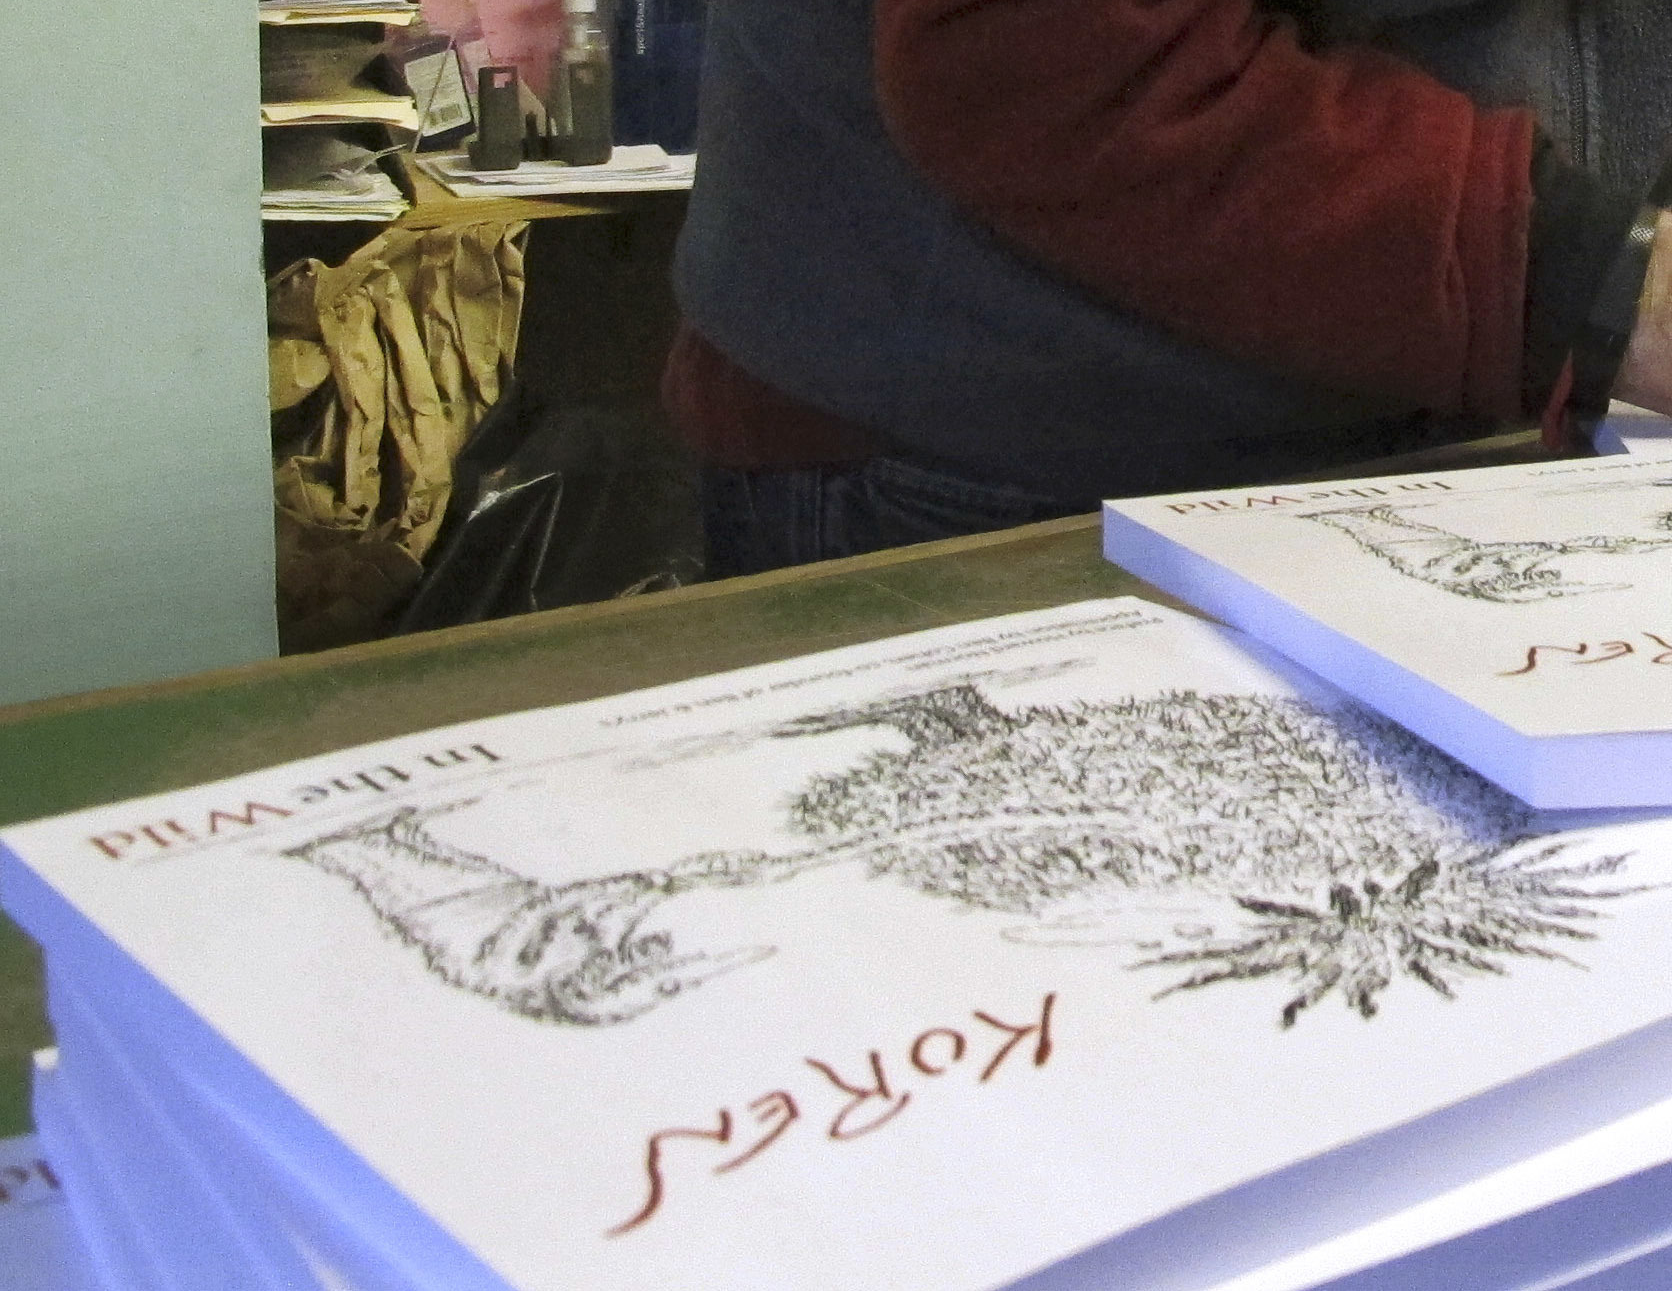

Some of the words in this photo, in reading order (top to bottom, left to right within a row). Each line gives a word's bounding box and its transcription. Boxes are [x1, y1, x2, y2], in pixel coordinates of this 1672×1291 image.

[1307, 487, 1389, 501] the
[1397, 480, 1453, 492] In
[1165, 494, 1302, 516] Wild
[422, 742, 503, 766] In
[302, 765, 410, 806] the
[87, 800, 293, 863] Wild
[607, 992, 1061, 1240] KOREN
